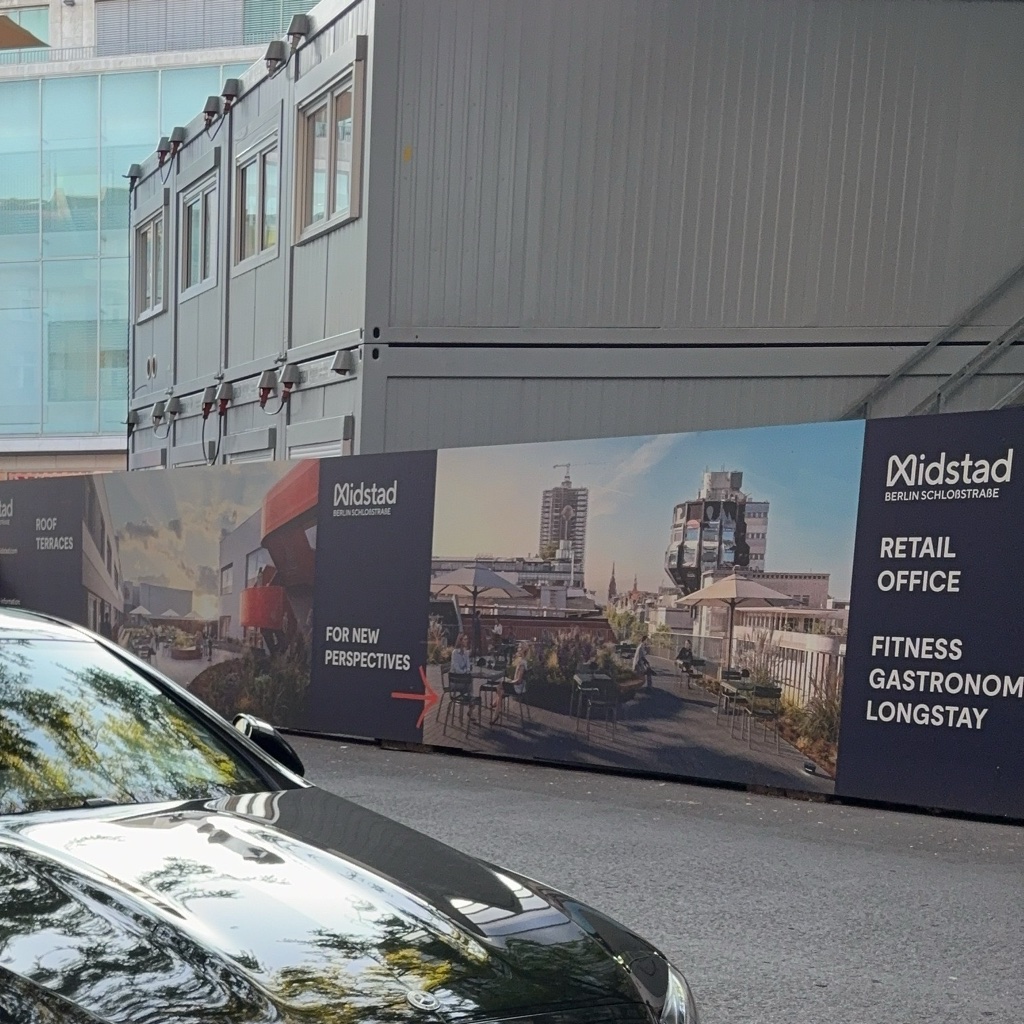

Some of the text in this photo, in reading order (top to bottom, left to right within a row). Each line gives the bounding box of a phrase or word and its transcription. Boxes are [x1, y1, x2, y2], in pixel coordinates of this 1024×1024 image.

[886, 448, 1014, 488] Midstad
[333, 479, 398, 507] Midstad
[884, 490, 920, 502] BERLIN
[35, 517, 57, 531] ROOF
[333, 509, 352, 517] BERLIN
[35, 536, 74, 550] TERRACES
[880, 536, 956, 559] RETAIL
[877, 570, 962, 592] OFFICE
[325, 626, 380, 644] FOR NEW
[871, 635, 963, 660] FITNESS
[324, 649, 411, 671] PERSPECTIVES
[866, 700, 989, 730] LONGSTAY
